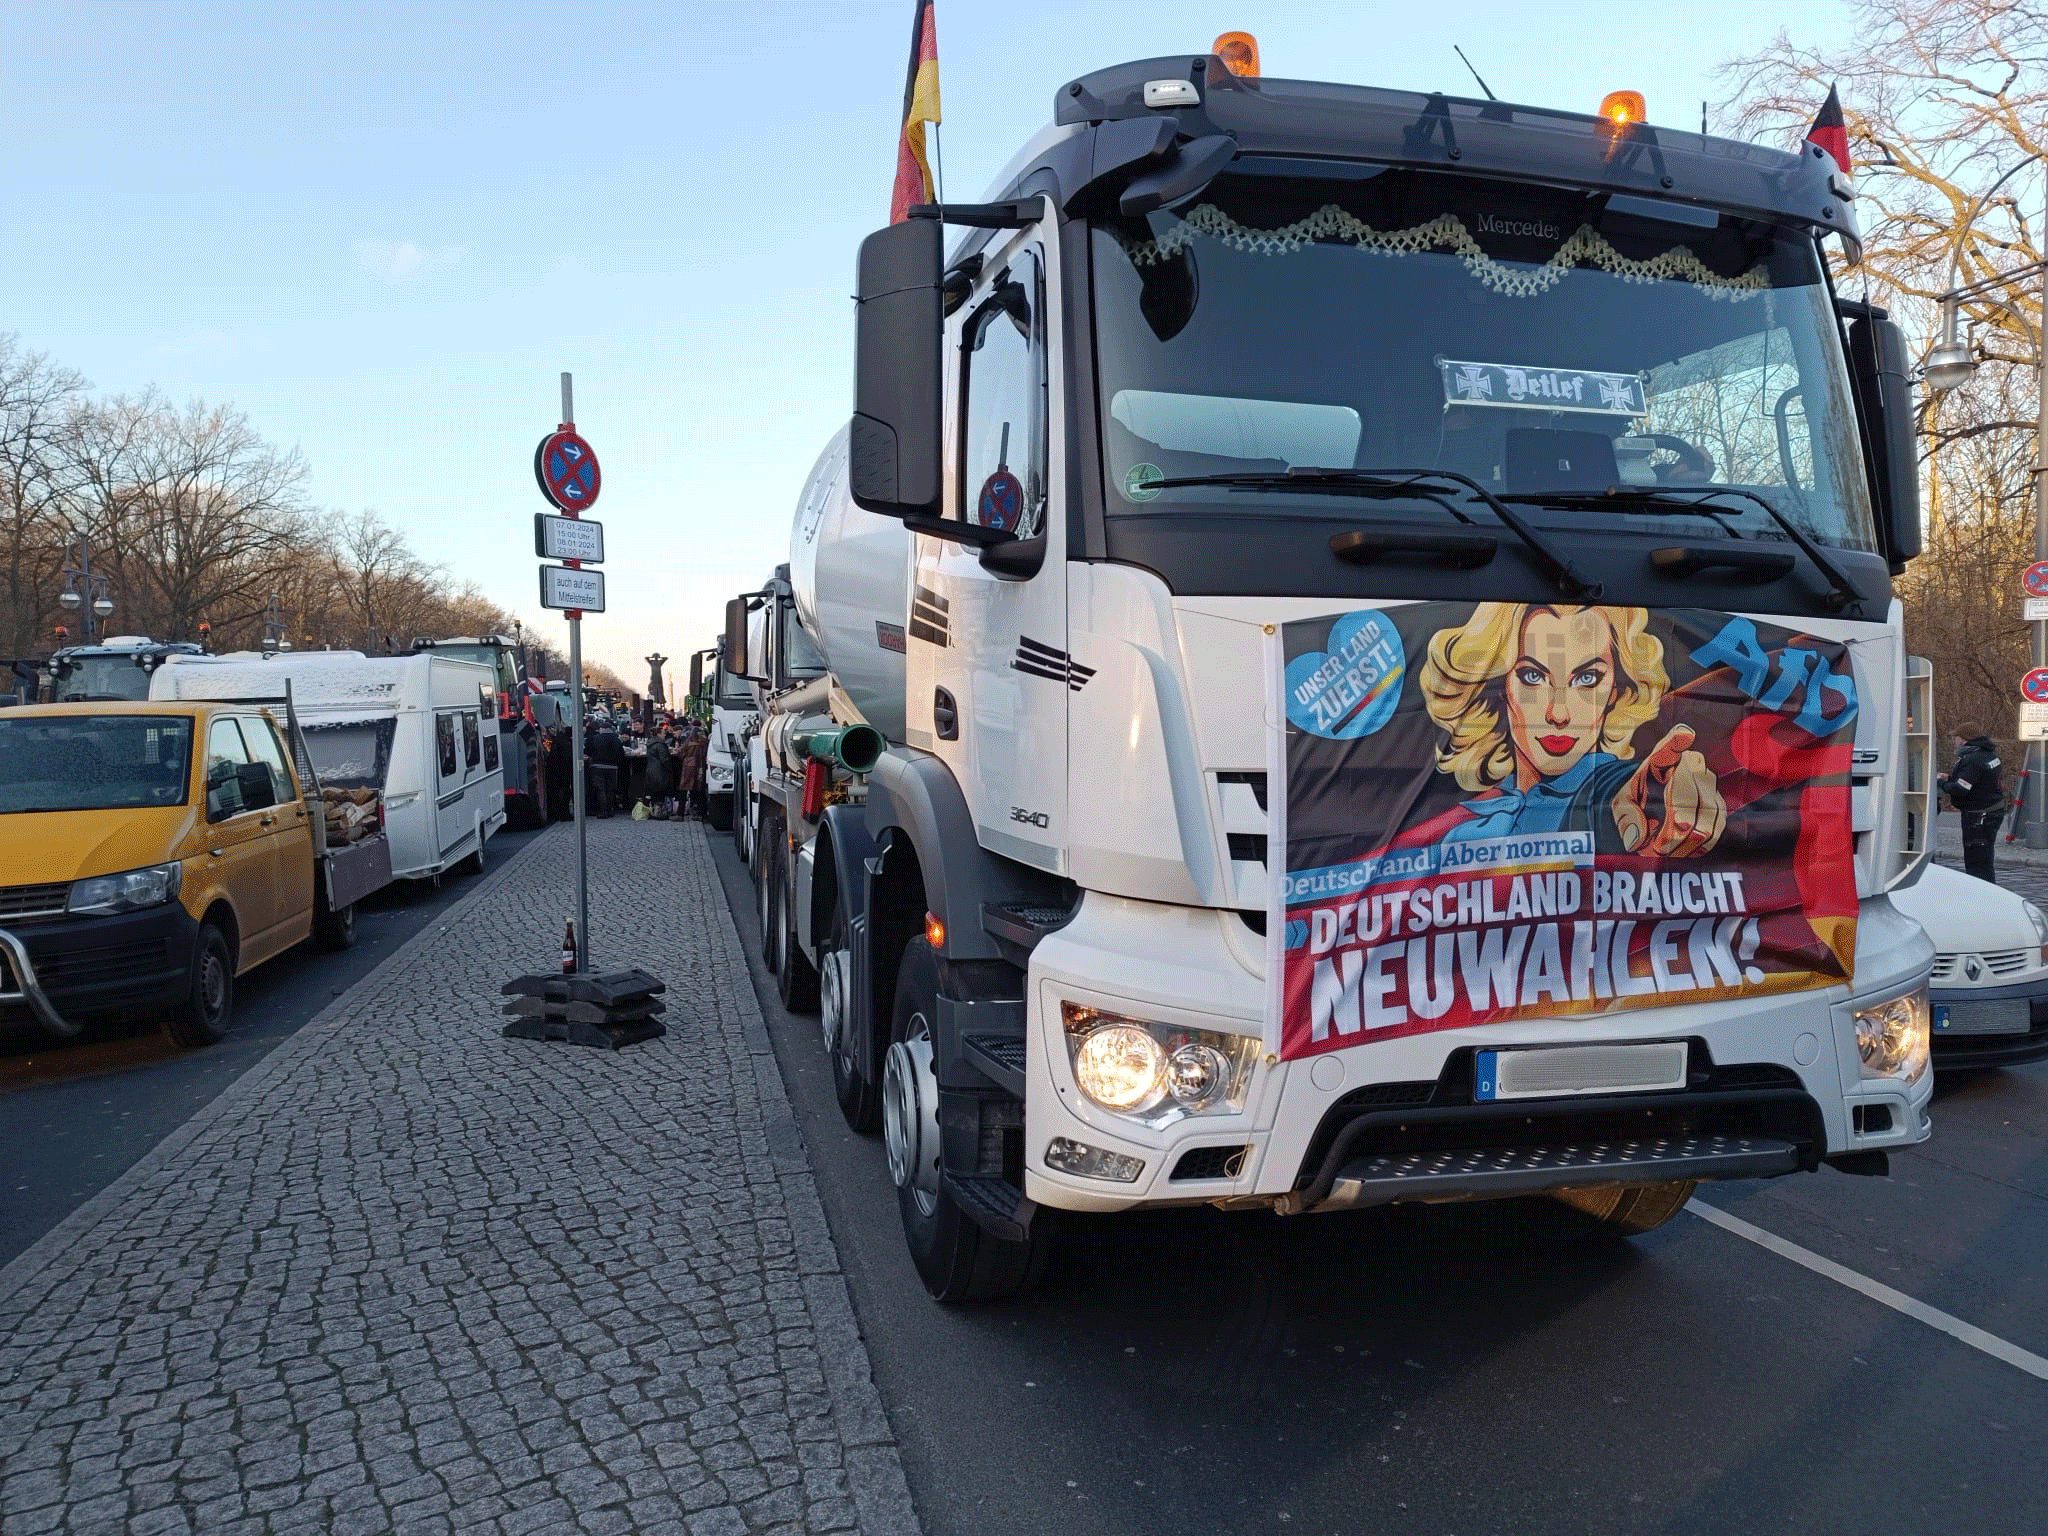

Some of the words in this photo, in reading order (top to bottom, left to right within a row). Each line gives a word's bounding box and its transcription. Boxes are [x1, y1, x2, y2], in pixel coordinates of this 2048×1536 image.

[1477, 213, 1560, 240] Mercedes
[1503, 367, 1584, 402] Detlef
[556, 577, 572, 587] auch
[573, 578, 583, 589] auf
[584, 579, 597, 591] dem
[558, 591, 596, 605] Mittelstreifen
[1294, 656, 1344, 705] UNSER
[1340, 620, 1380, 663] LAND
[1688, 616, 1859, 738] AfD
[1308, 638, 1398, 731] ZUERST!
[1010, 806, 1049, 829] 3640
[1441, 842, 1501, 868] Aber
[1506, 833, 1594, 860] normal
[1310, 872, 1581, 955] DEUTSCHLAND
[1593, 872, 1747, 914] BRAUCHT
[1310, 916, 1765, 1043] NEUWAHLEN!
[1482, 1081, 1490, 1092] D
